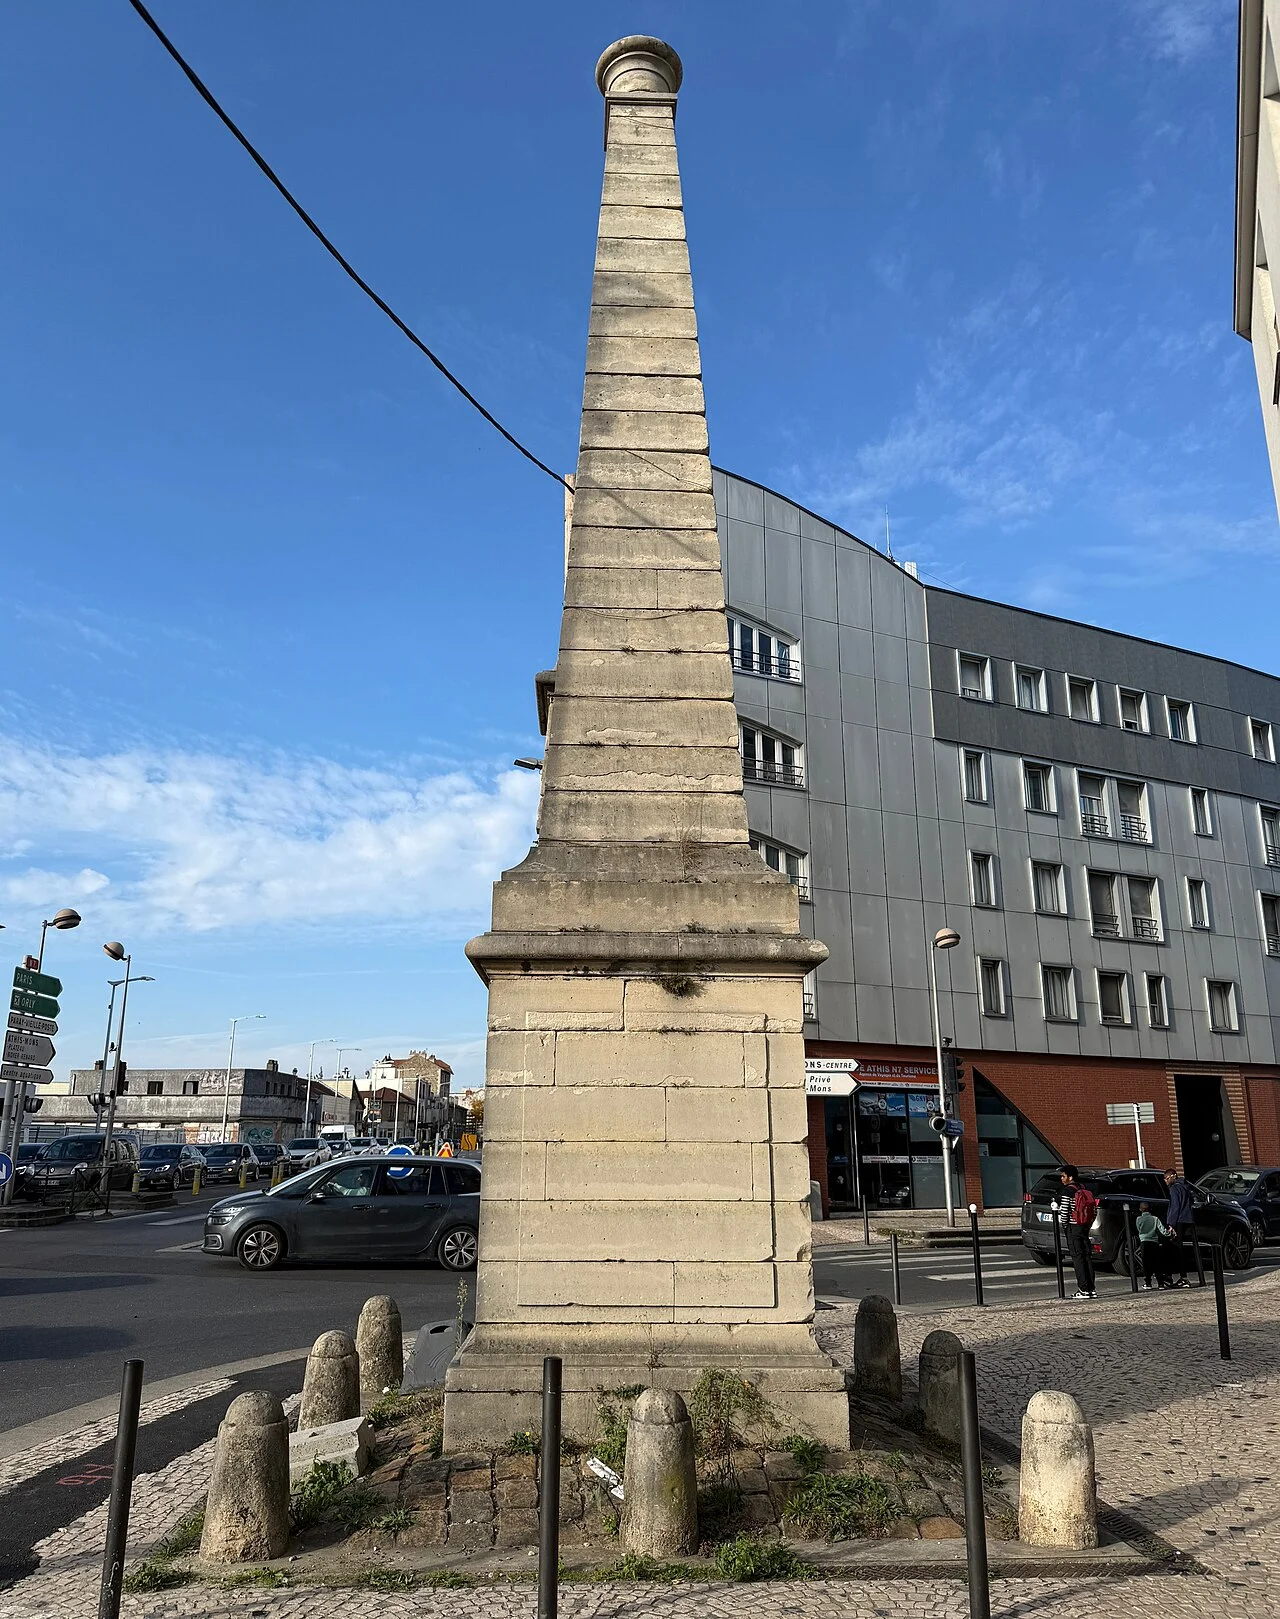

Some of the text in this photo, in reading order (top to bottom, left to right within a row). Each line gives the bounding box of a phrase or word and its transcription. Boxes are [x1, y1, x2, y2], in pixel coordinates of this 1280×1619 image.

[16, 972, 33, 985] PARIS
[21, 997, 36, 1009] ORLY
[8, 1034, 39, 1047] ATHIS-MONS
[805, 1061, 853, 1069] ONS-CENTRE
[866, 1064, 890, 1073] ATHIS
[904, 1066, 939, 1075] SERVICE
[810, 1075, 831, 1083] Privé
